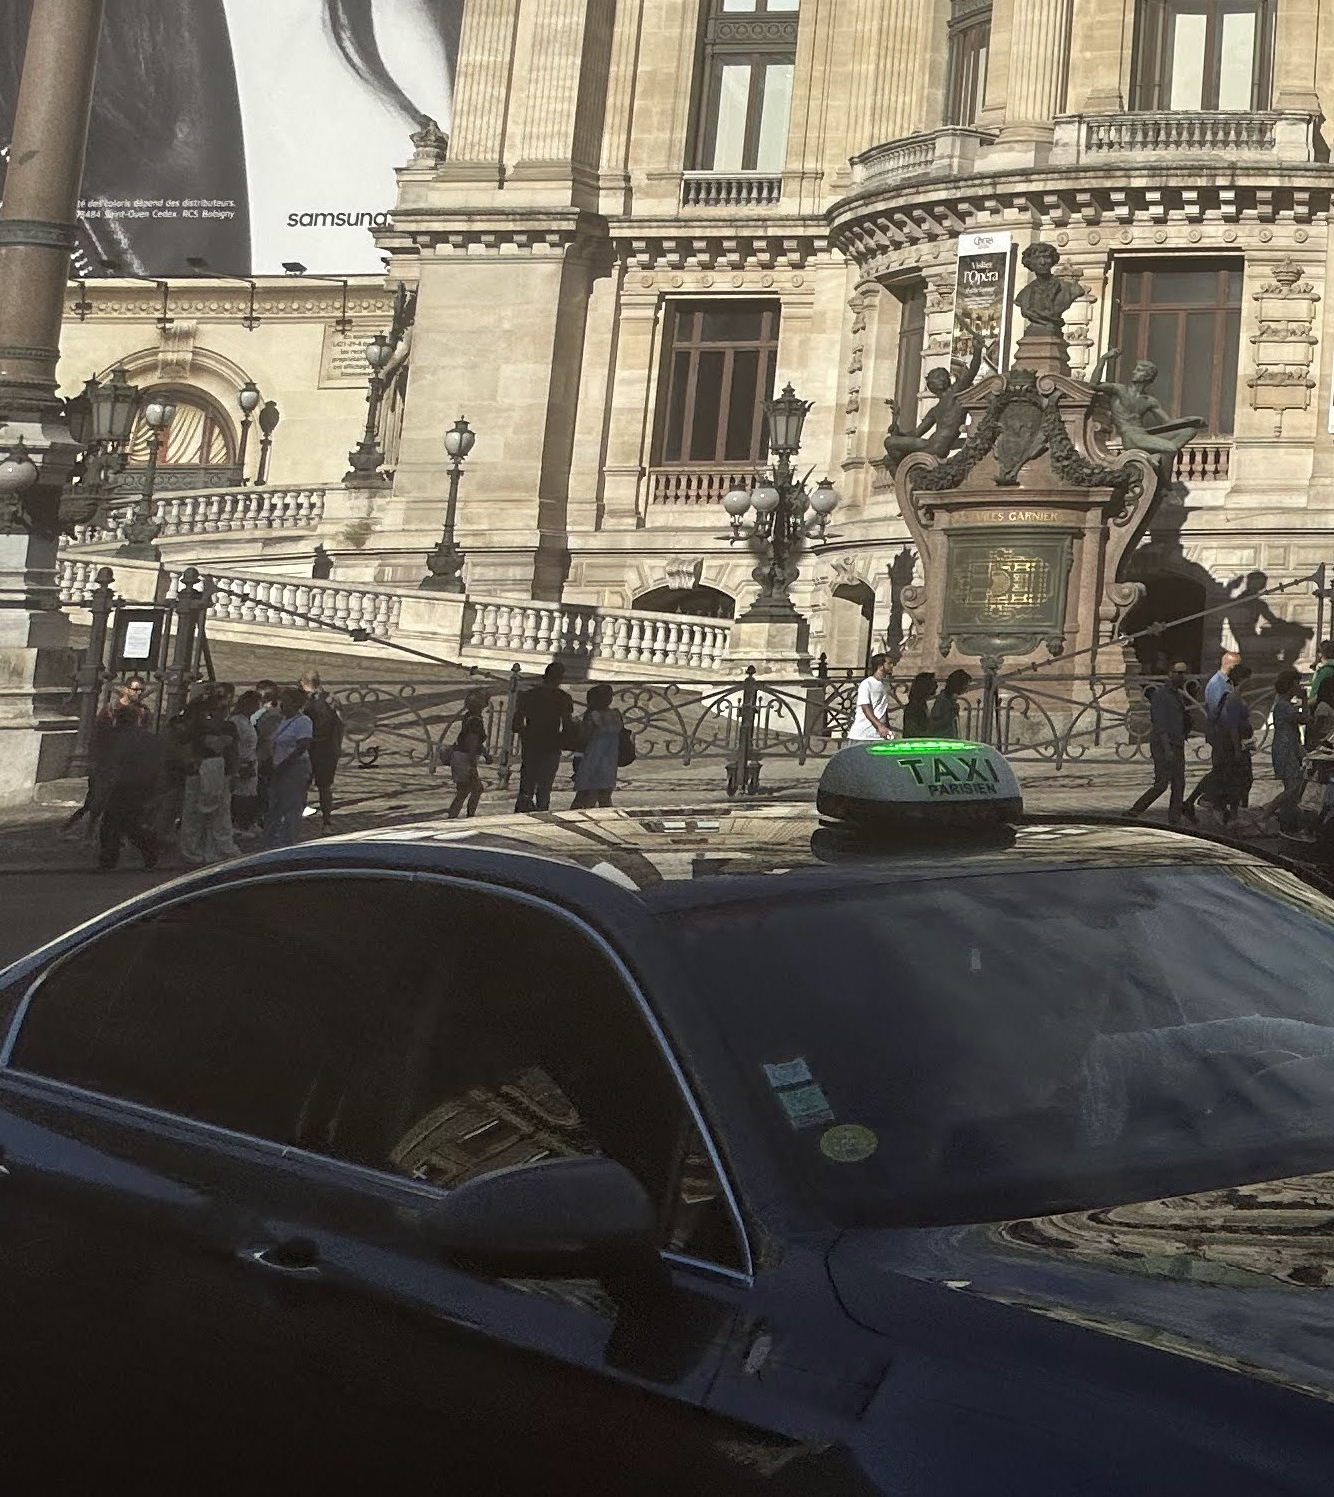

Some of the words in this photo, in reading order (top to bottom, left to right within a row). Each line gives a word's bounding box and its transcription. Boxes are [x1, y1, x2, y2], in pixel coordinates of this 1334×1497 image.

[1008, 511, 1059, 522] GARNIER
[898, 757, 1000, 785] TAXI
[928, 782, 998, 796] PARISIEN
